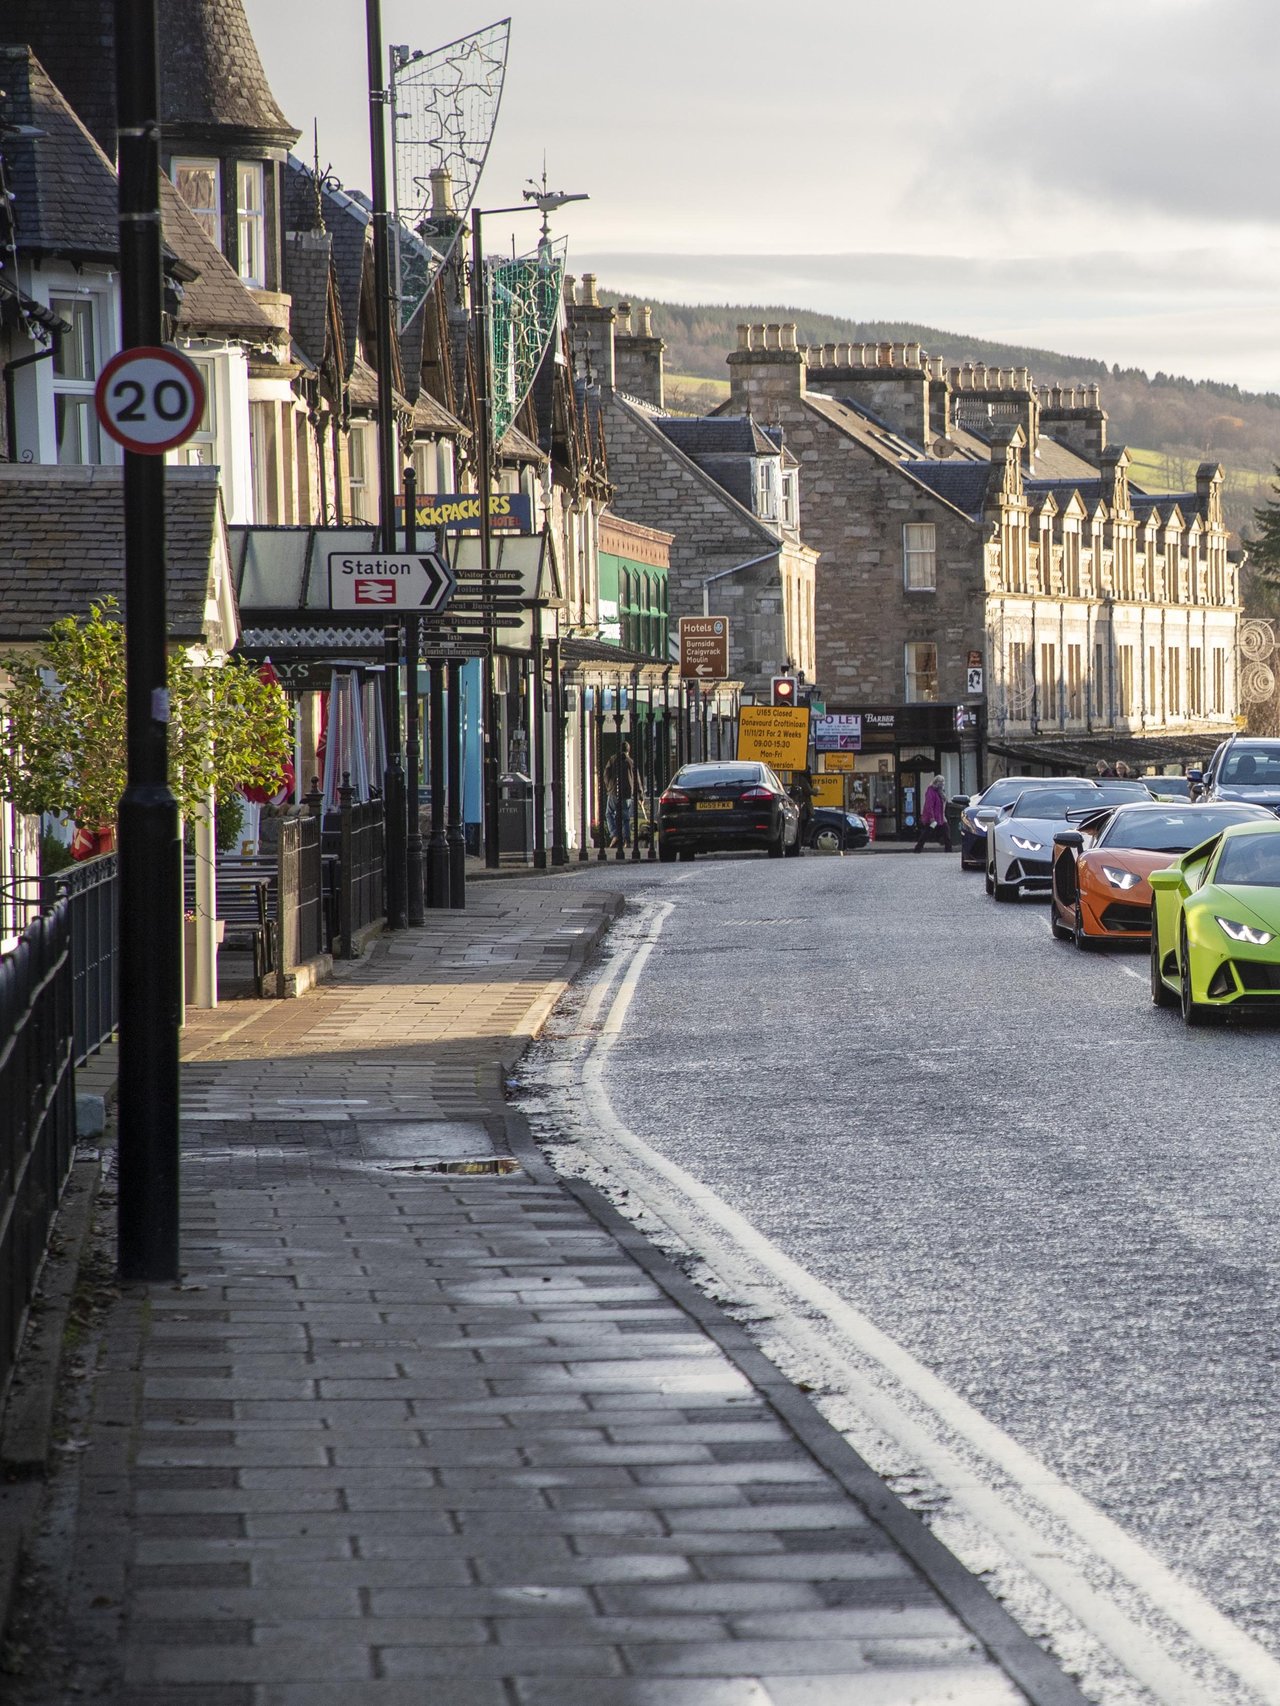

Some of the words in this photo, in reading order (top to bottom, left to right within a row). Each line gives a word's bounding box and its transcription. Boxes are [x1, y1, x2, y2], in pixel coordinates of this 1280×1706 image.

[113, 379, 188, 422] 20
[342, 559, 411, 575] Station
[458, 571, 485, 579] Visitor
[488, 571, 516, 579] Centre
[457, 585, 483, 593] Toilets
[451, 616, 485, 625] Distance
[683, 624, 712, 632] Hotels
[686, 640, 715, 648] Burnside
[772, 709, 793, 717] Closed
[838, 715, 860, 724] LET
[865, 713, 894, 723] BARBER
[741, 718, 772, 727] Donavourd
[744, 729, 765, 737] 11/11/21
[783, 730, 802, 738] Weeks
[760, 750, 783, 758] Mon-Fri
[768, 761, 794, 769] Diversion
